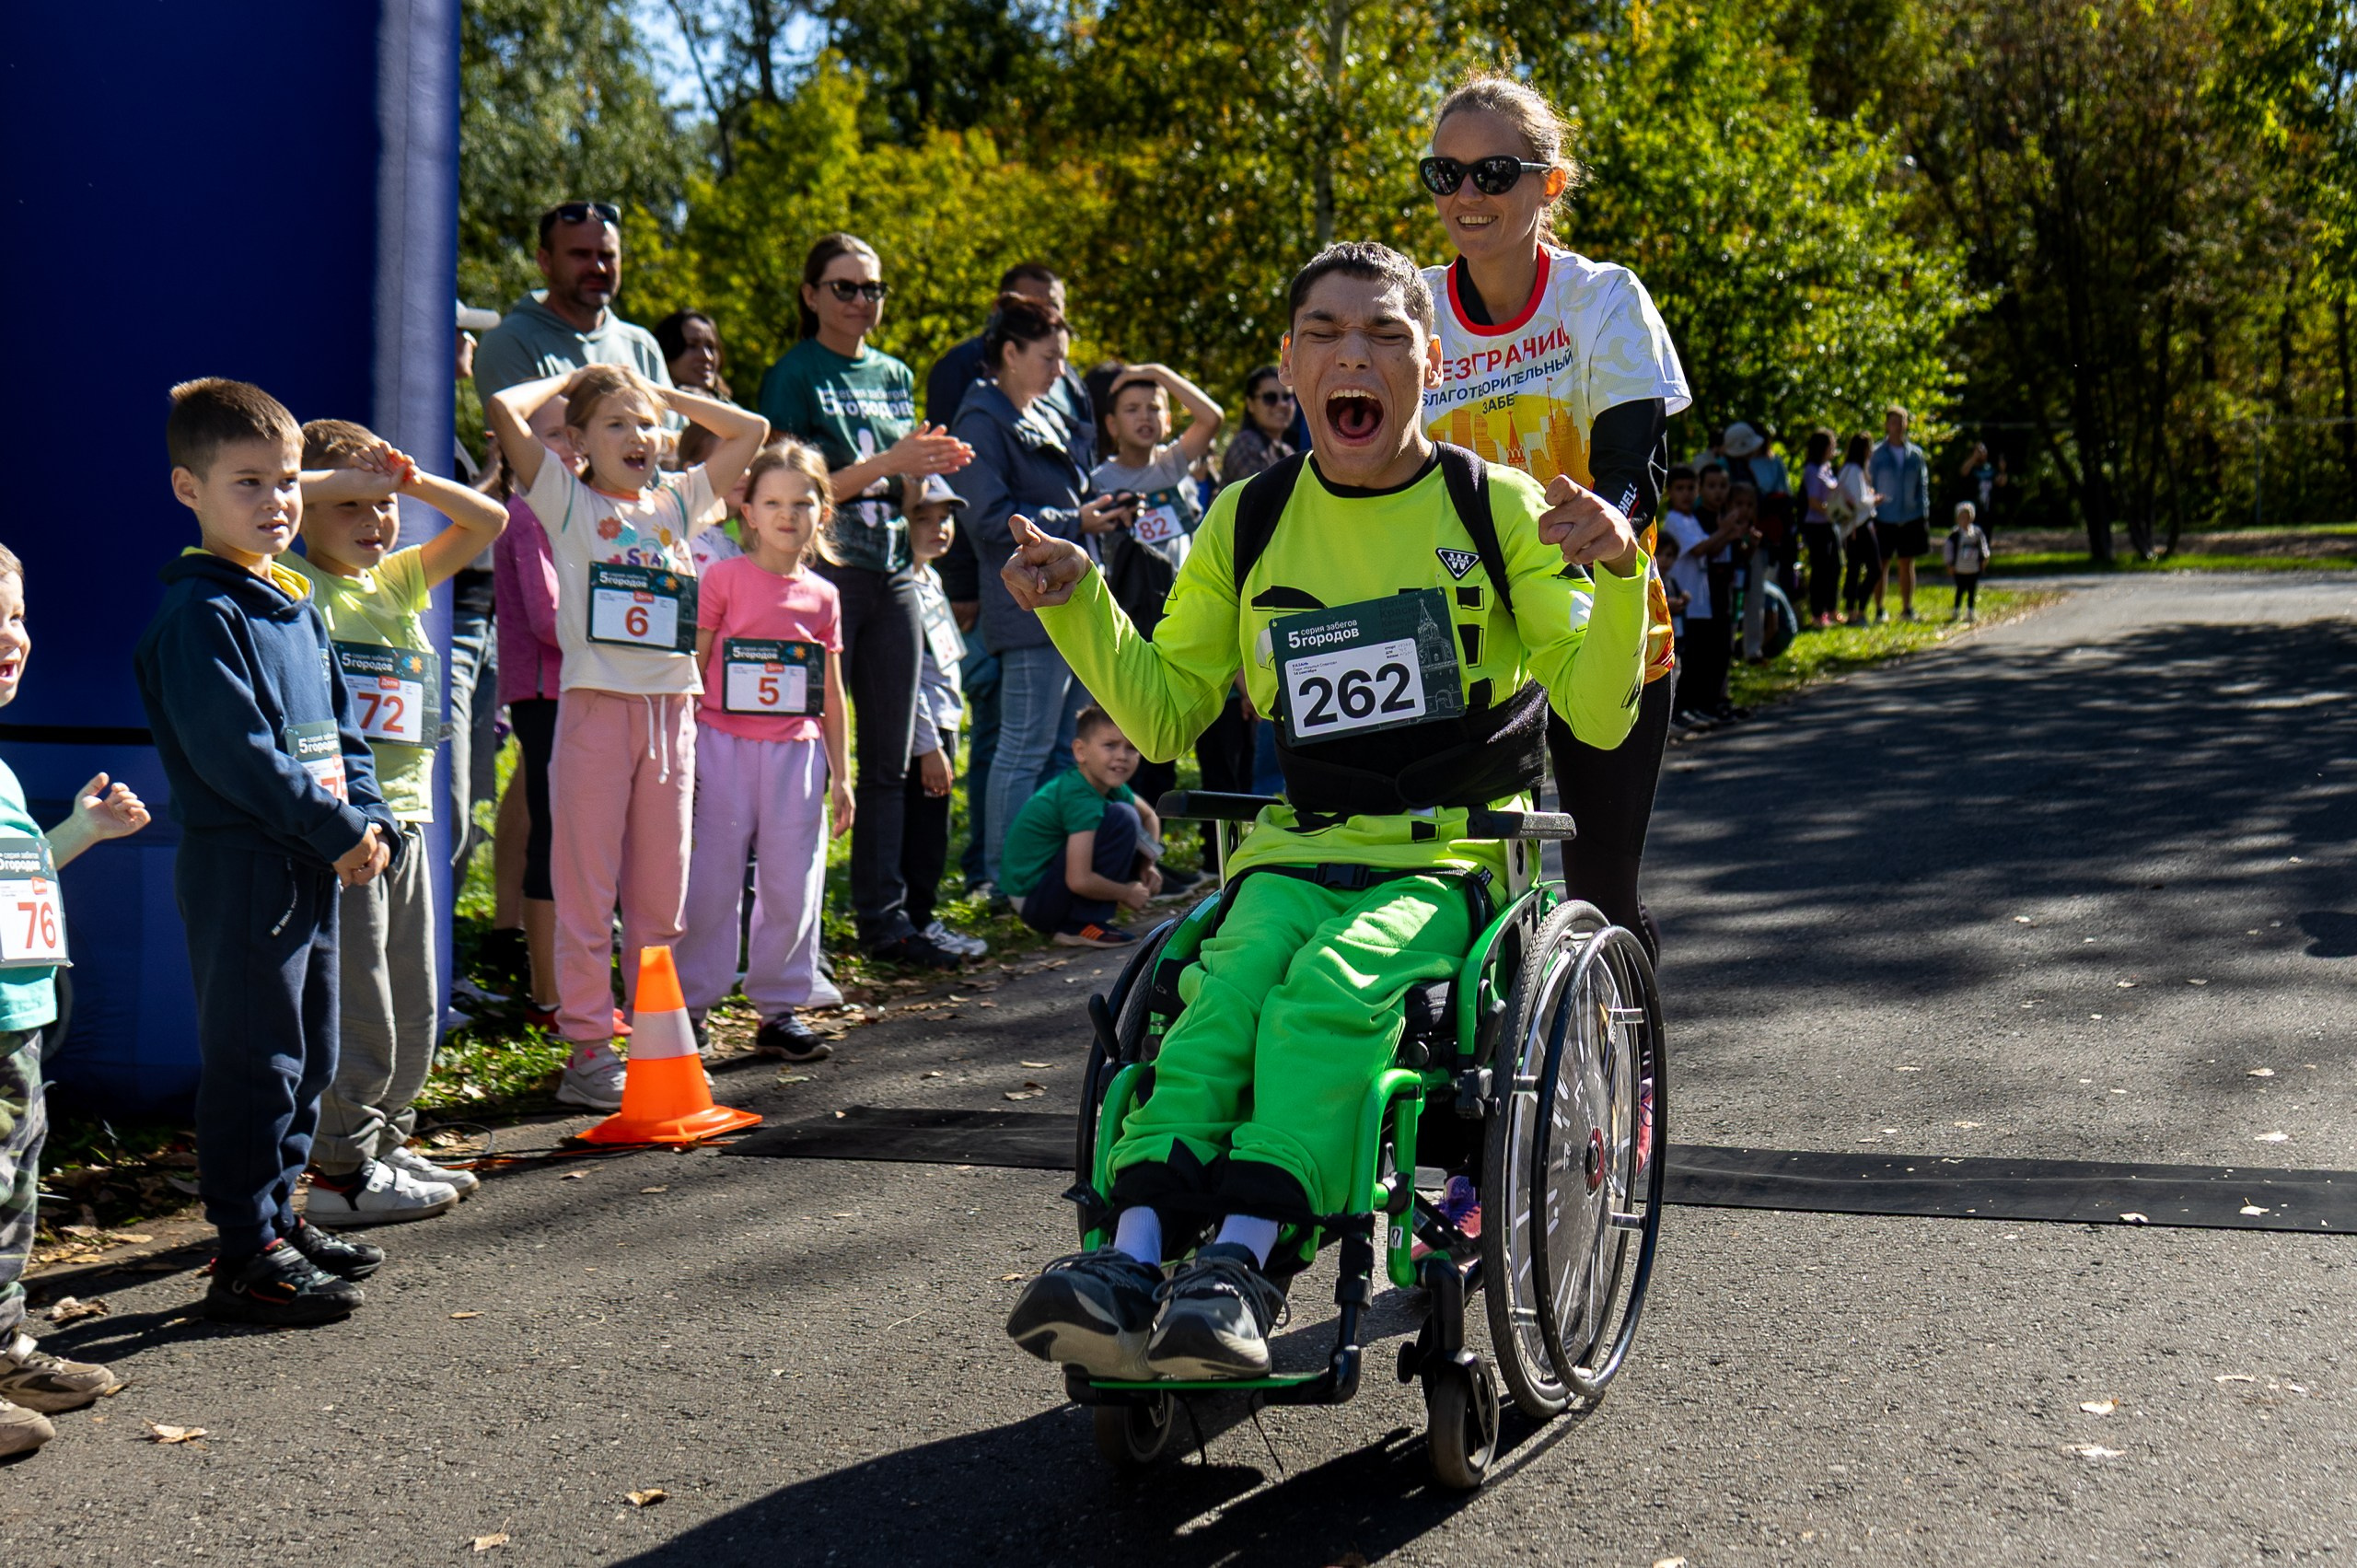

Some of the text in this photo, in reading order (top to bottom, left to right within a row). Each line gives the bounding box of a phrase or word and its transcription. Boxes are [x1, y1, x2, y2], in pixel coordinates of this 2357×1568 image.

[1482, 391, 1518, 414] ЗАБЕ
[1139, 517, 1171, 540] 82
[627, 547, 665, 567] STA
[599, 572, 608, 584] 5
[625, 606, 649, 637] 6
[1301, 620, 1358, 636] серия забегов
[1288, 628, 1360, 648] 5 городов
[342, 653, 394, 672] 5 городов
[733, 646, 740, 658] 5
[758, 677, 780, 706] 5
[1298, 662, 1416, 727] 262
[357, 691, 404, 734] 72
[298, 738, 308, 754] 5
[17, 901, 57, 949] 76
